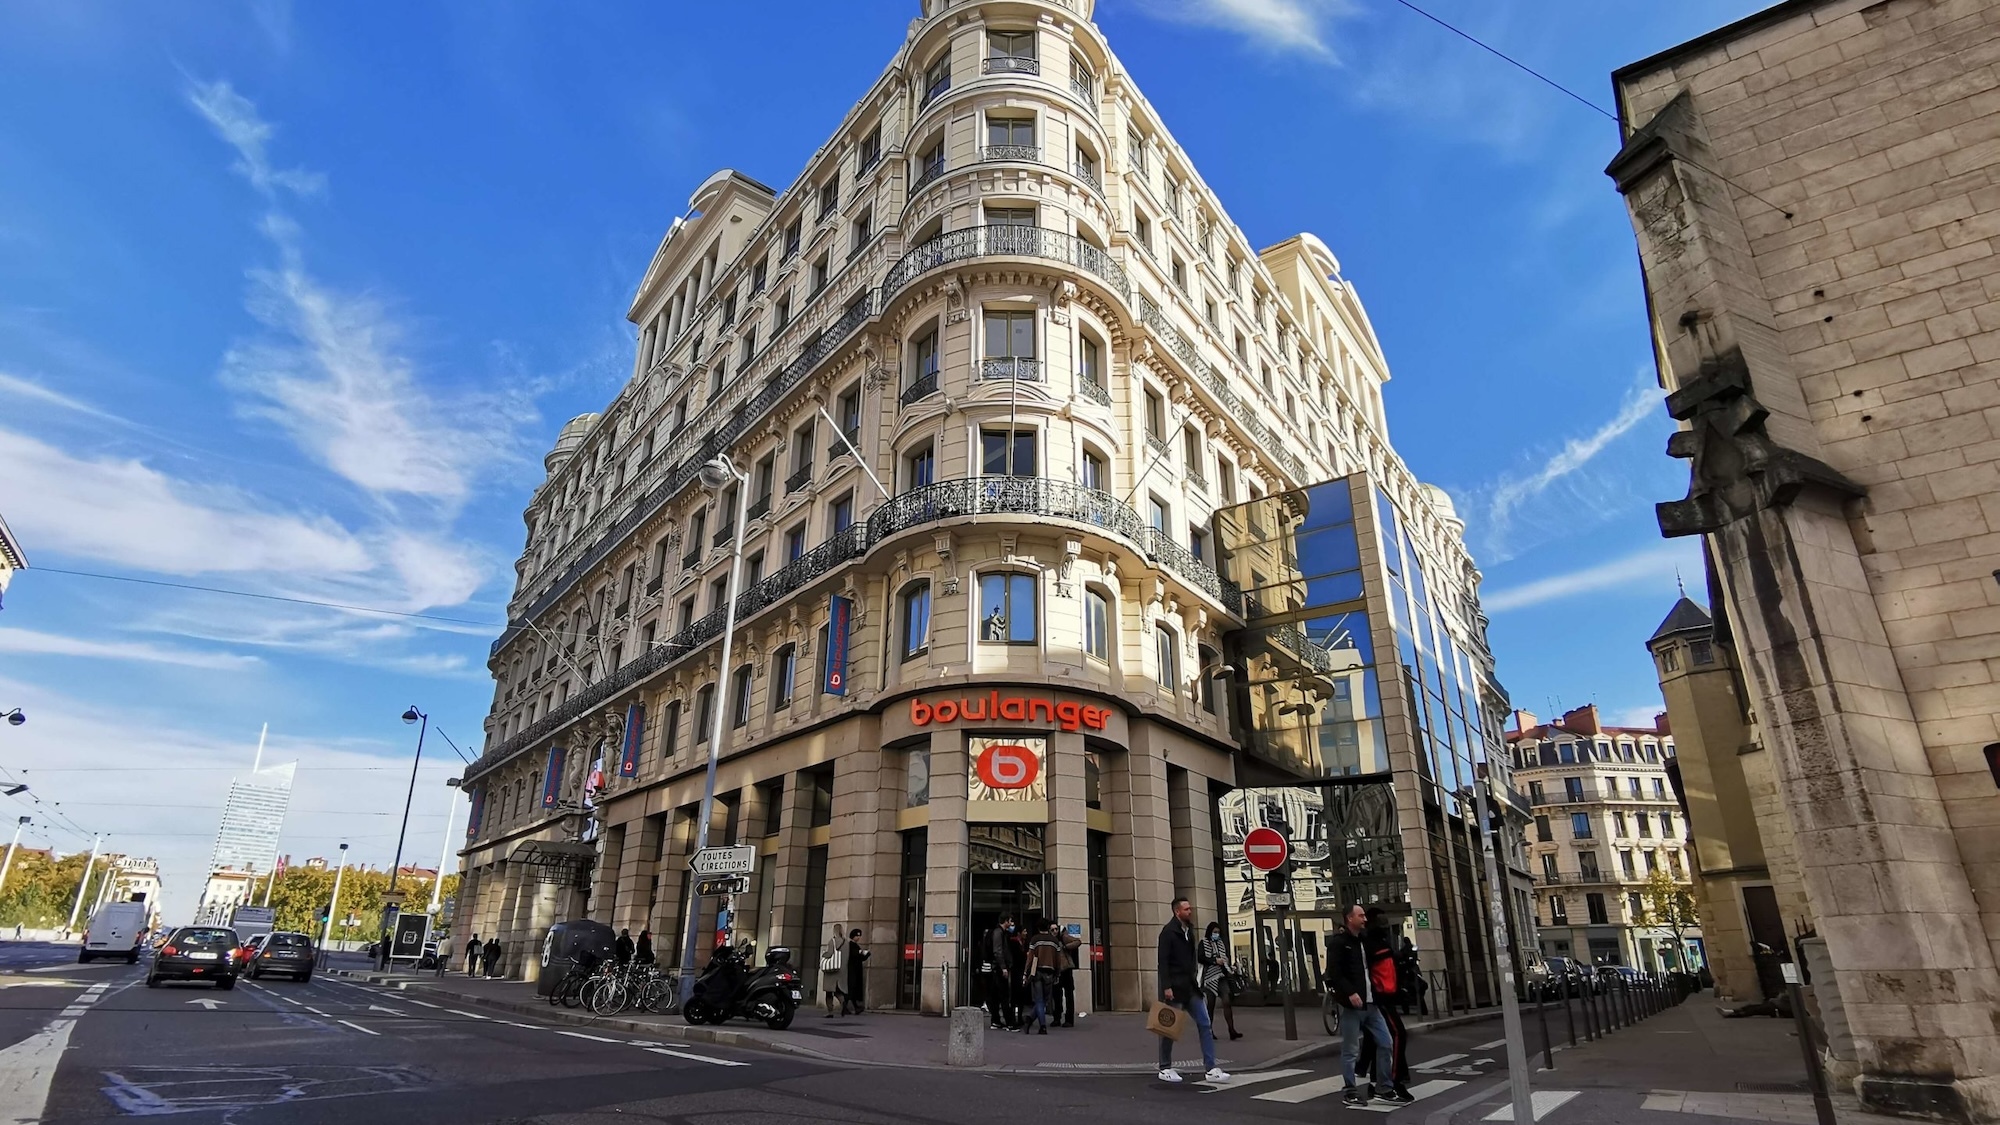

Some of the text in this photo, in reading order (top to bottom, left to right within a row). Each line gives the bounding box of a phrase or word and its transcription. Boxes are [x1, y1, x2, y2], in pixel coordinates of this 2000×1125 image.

[911, 690, 1112, 731] boulanger
[991, 747, 1026, 784] b
[703, 852, 732, 861] TOUTES
[701, 860, 747, 871] DIRECTIONS
[703, 883, 709, 894] P
